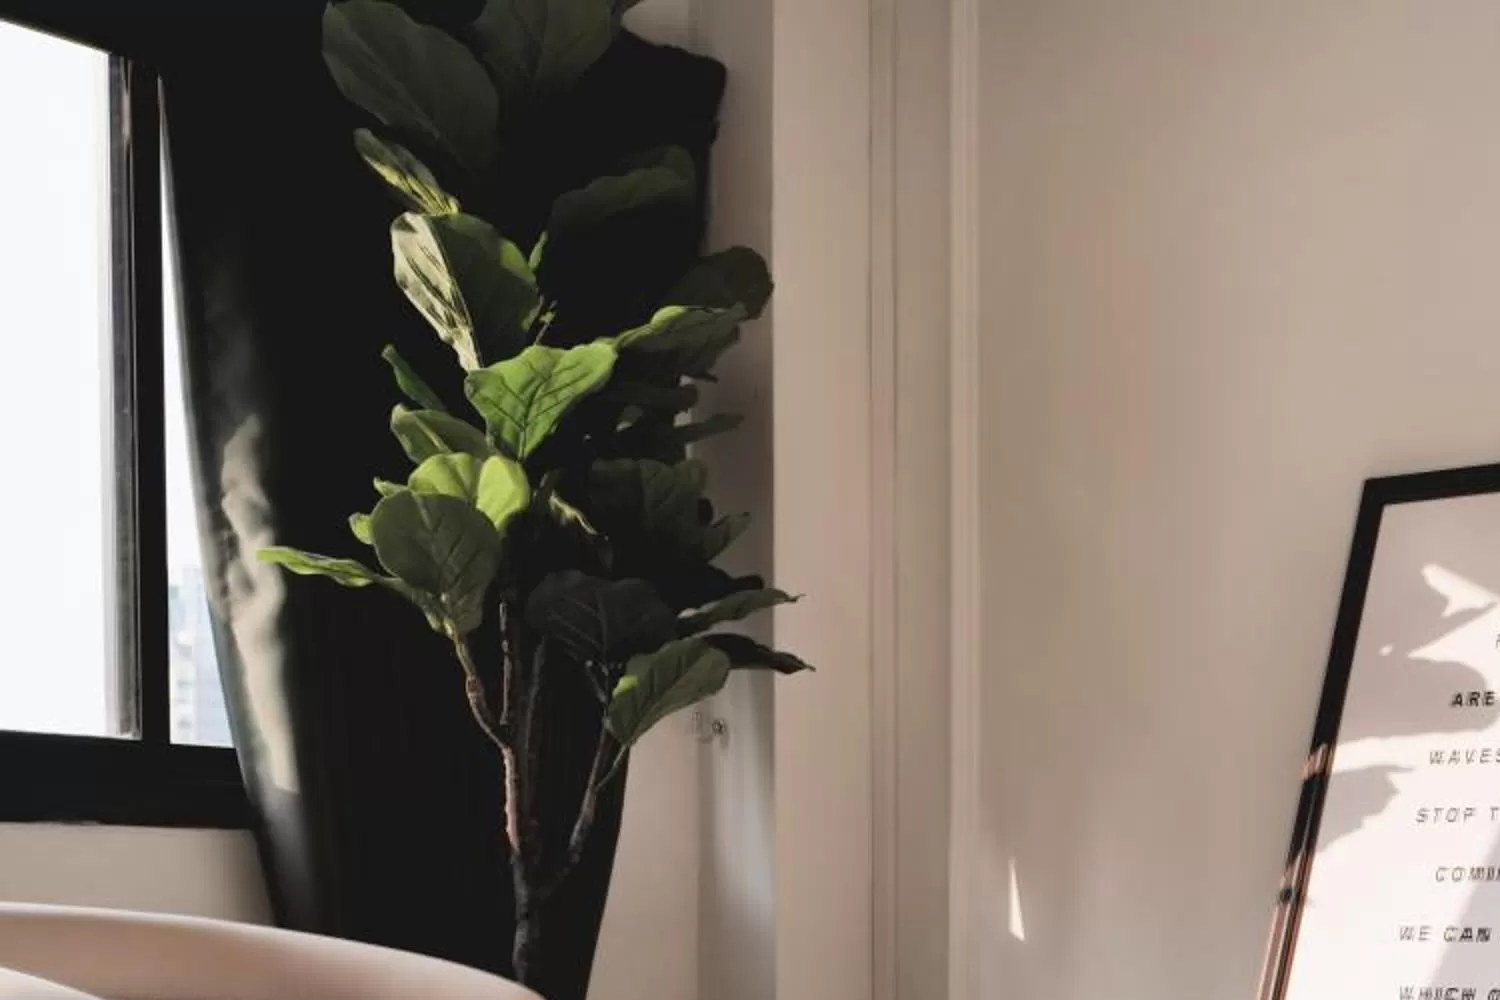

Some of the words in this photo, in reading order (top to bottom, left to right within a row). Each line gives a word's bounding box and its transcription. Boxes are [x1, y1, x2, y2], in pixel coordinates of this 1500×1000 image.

[1450, 690, 1495, 707] ARE
[1416, 807, 1477, 823] STOP
[1399, 926, 1432, 942] WE
[1443, 927, 1492, 943] CAN
